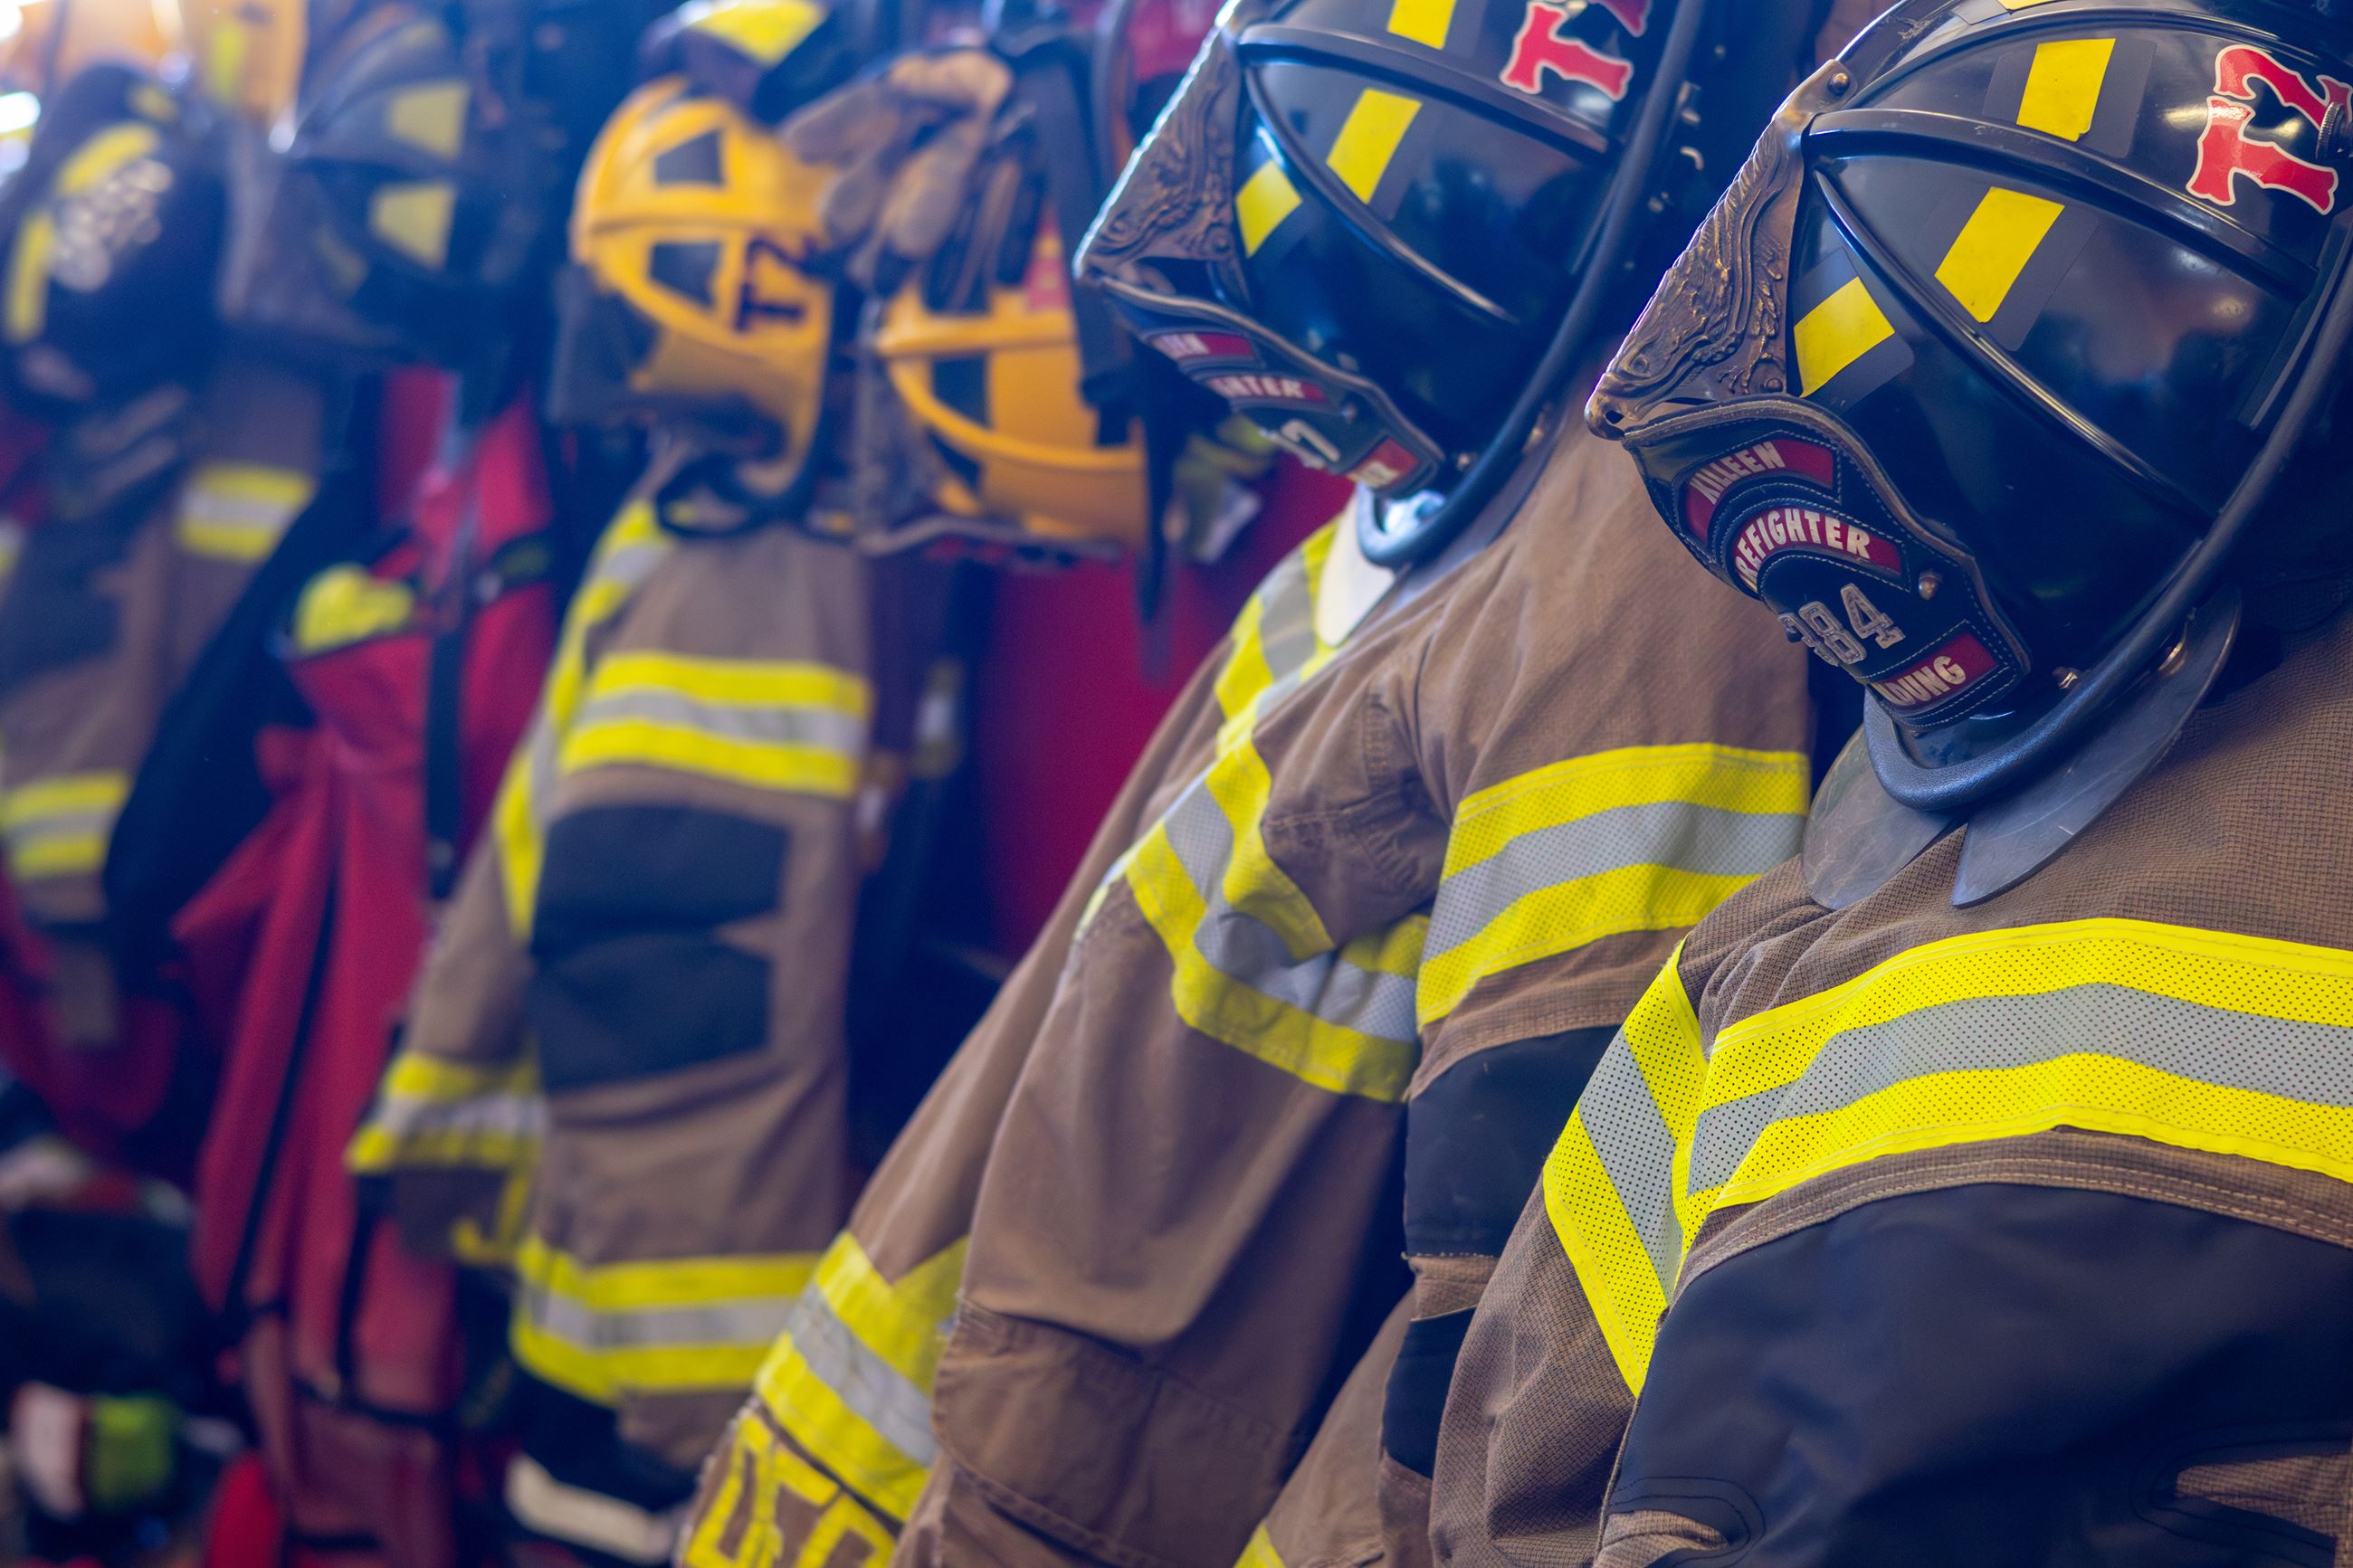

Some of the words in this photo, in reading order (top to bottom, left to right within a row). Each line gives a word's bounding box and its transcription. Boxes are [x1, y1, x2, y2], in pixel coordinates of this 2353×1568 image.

[2186, 44, 2353, 215] T2
[1689, 441, 1786, 506] KILLEEN
[1735, 508, 1871, 594] REFIGHTER
[1871, 655, 1967, 707] OUNG
